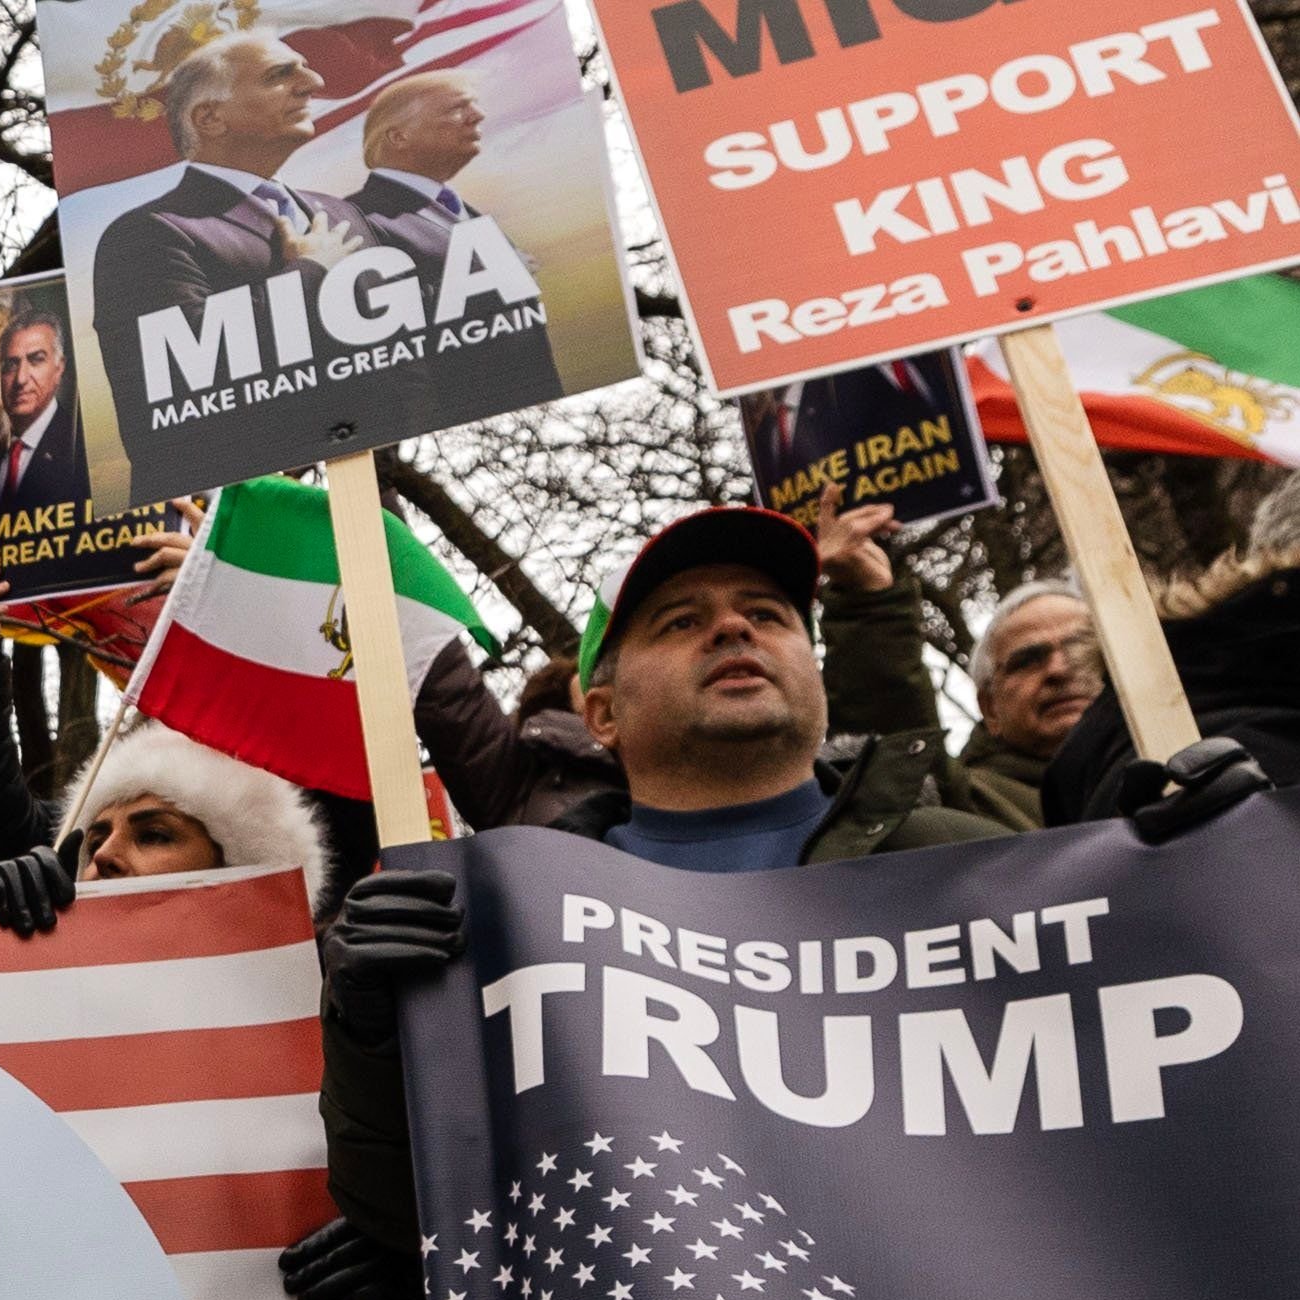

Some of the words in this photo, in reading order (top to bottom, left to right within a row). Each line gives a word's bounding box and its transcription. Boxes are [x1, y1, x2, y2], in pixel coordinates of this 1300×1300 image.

[650, 0, 1024, 93] MI
[703, 9, 1220, 191] SUPPORT
[834, 138, 1130, 256] KING
[136, 214, 543, 403] MIGA
[727, 272, 949, 355] Reza
[961, 174, 1300, 298] Pahlavi
[150, 386, 238, 431] MAKE
[244, 364, 318, 409] IRAN
[327, 334, 429, 381] GREAT
[437, 302, 548, 352] AGAIN
[769, 448, 850, 510] MAKE
[854, 414, 953, 470] IRAN
[854, 448, 961, 501] AGAIN
[75, 520, 166, 555] AGAIN
[561, 893, 1109, 994] PRESIDENT
[481, 962, 1246, 1137] TRUMP
